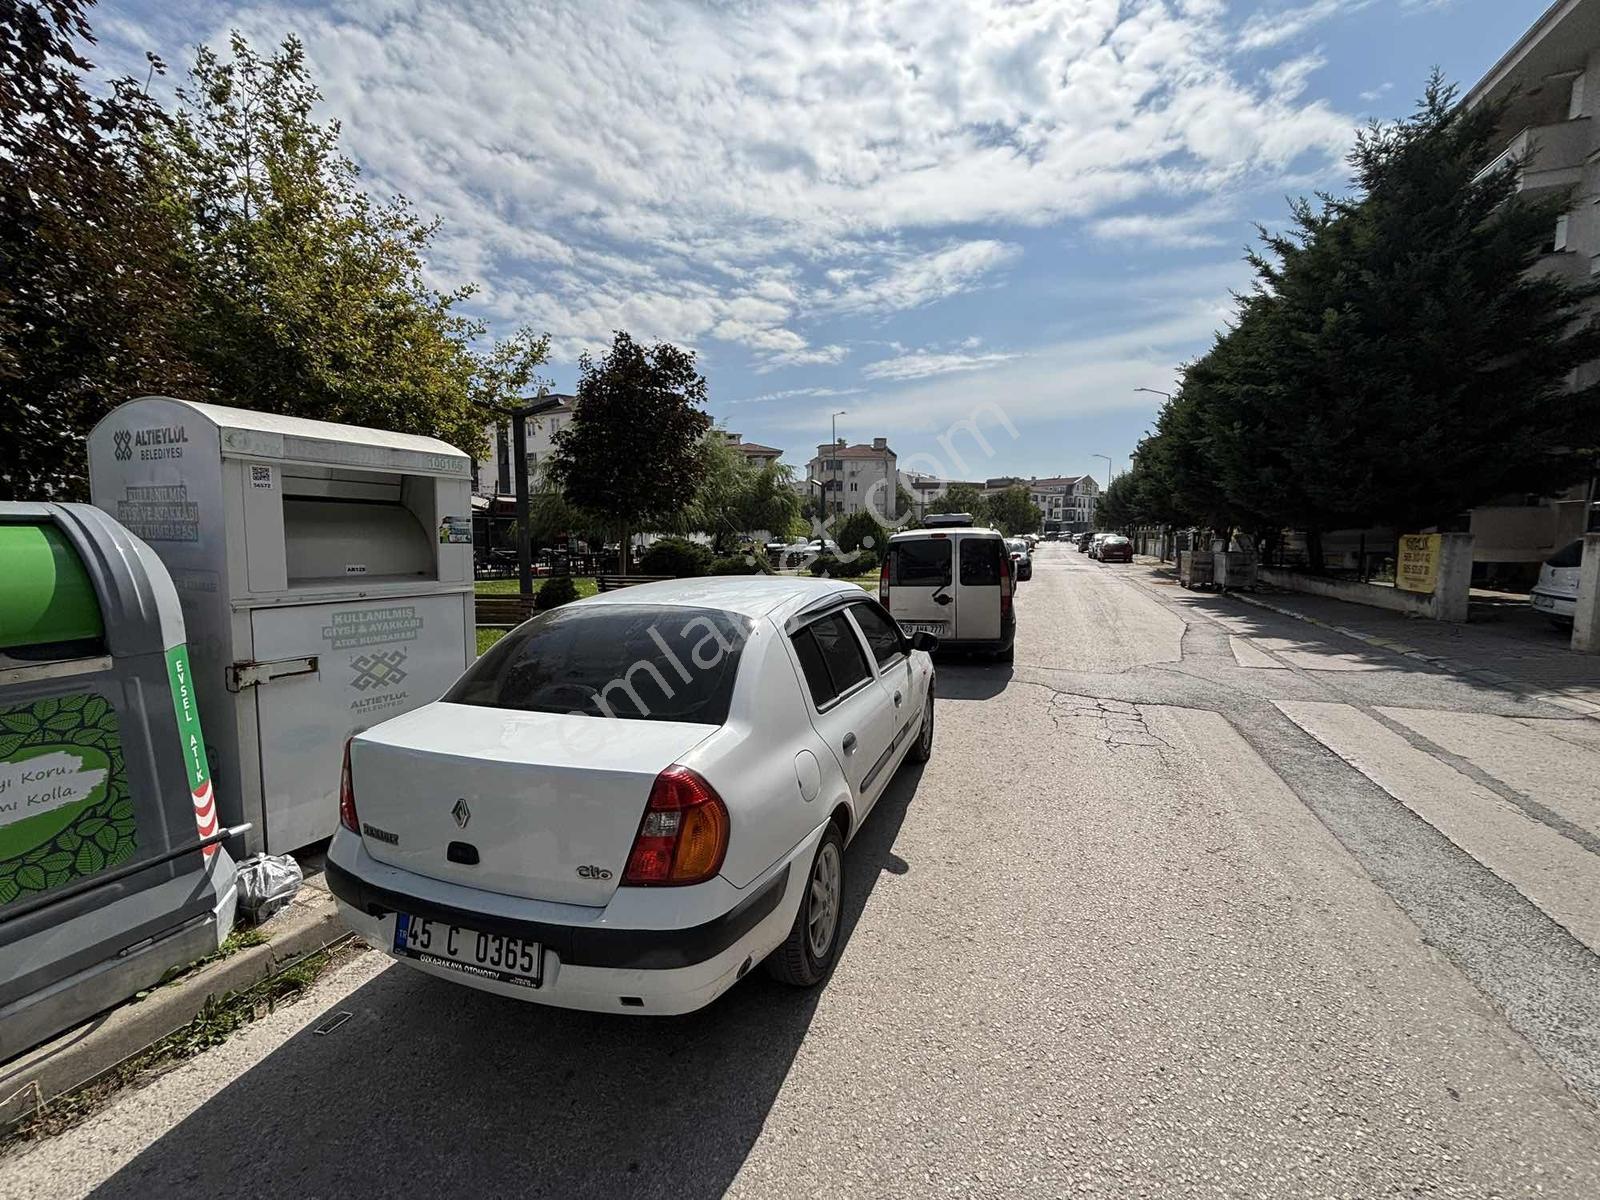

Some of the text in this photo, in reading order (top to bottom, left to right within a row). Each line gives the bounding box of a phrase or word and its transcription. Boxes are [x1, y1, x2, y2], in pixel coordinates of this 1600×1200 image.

[176, 660, 192, 721] EVSEL
[21, 767, 73, 784] Koru,
[190, 734, 204, 783] ATIK
[27, 786, 77, 806] Kolla.
[399, 929, 407, 939] TR
[409, 914, 534, 973] 45 C 0365
